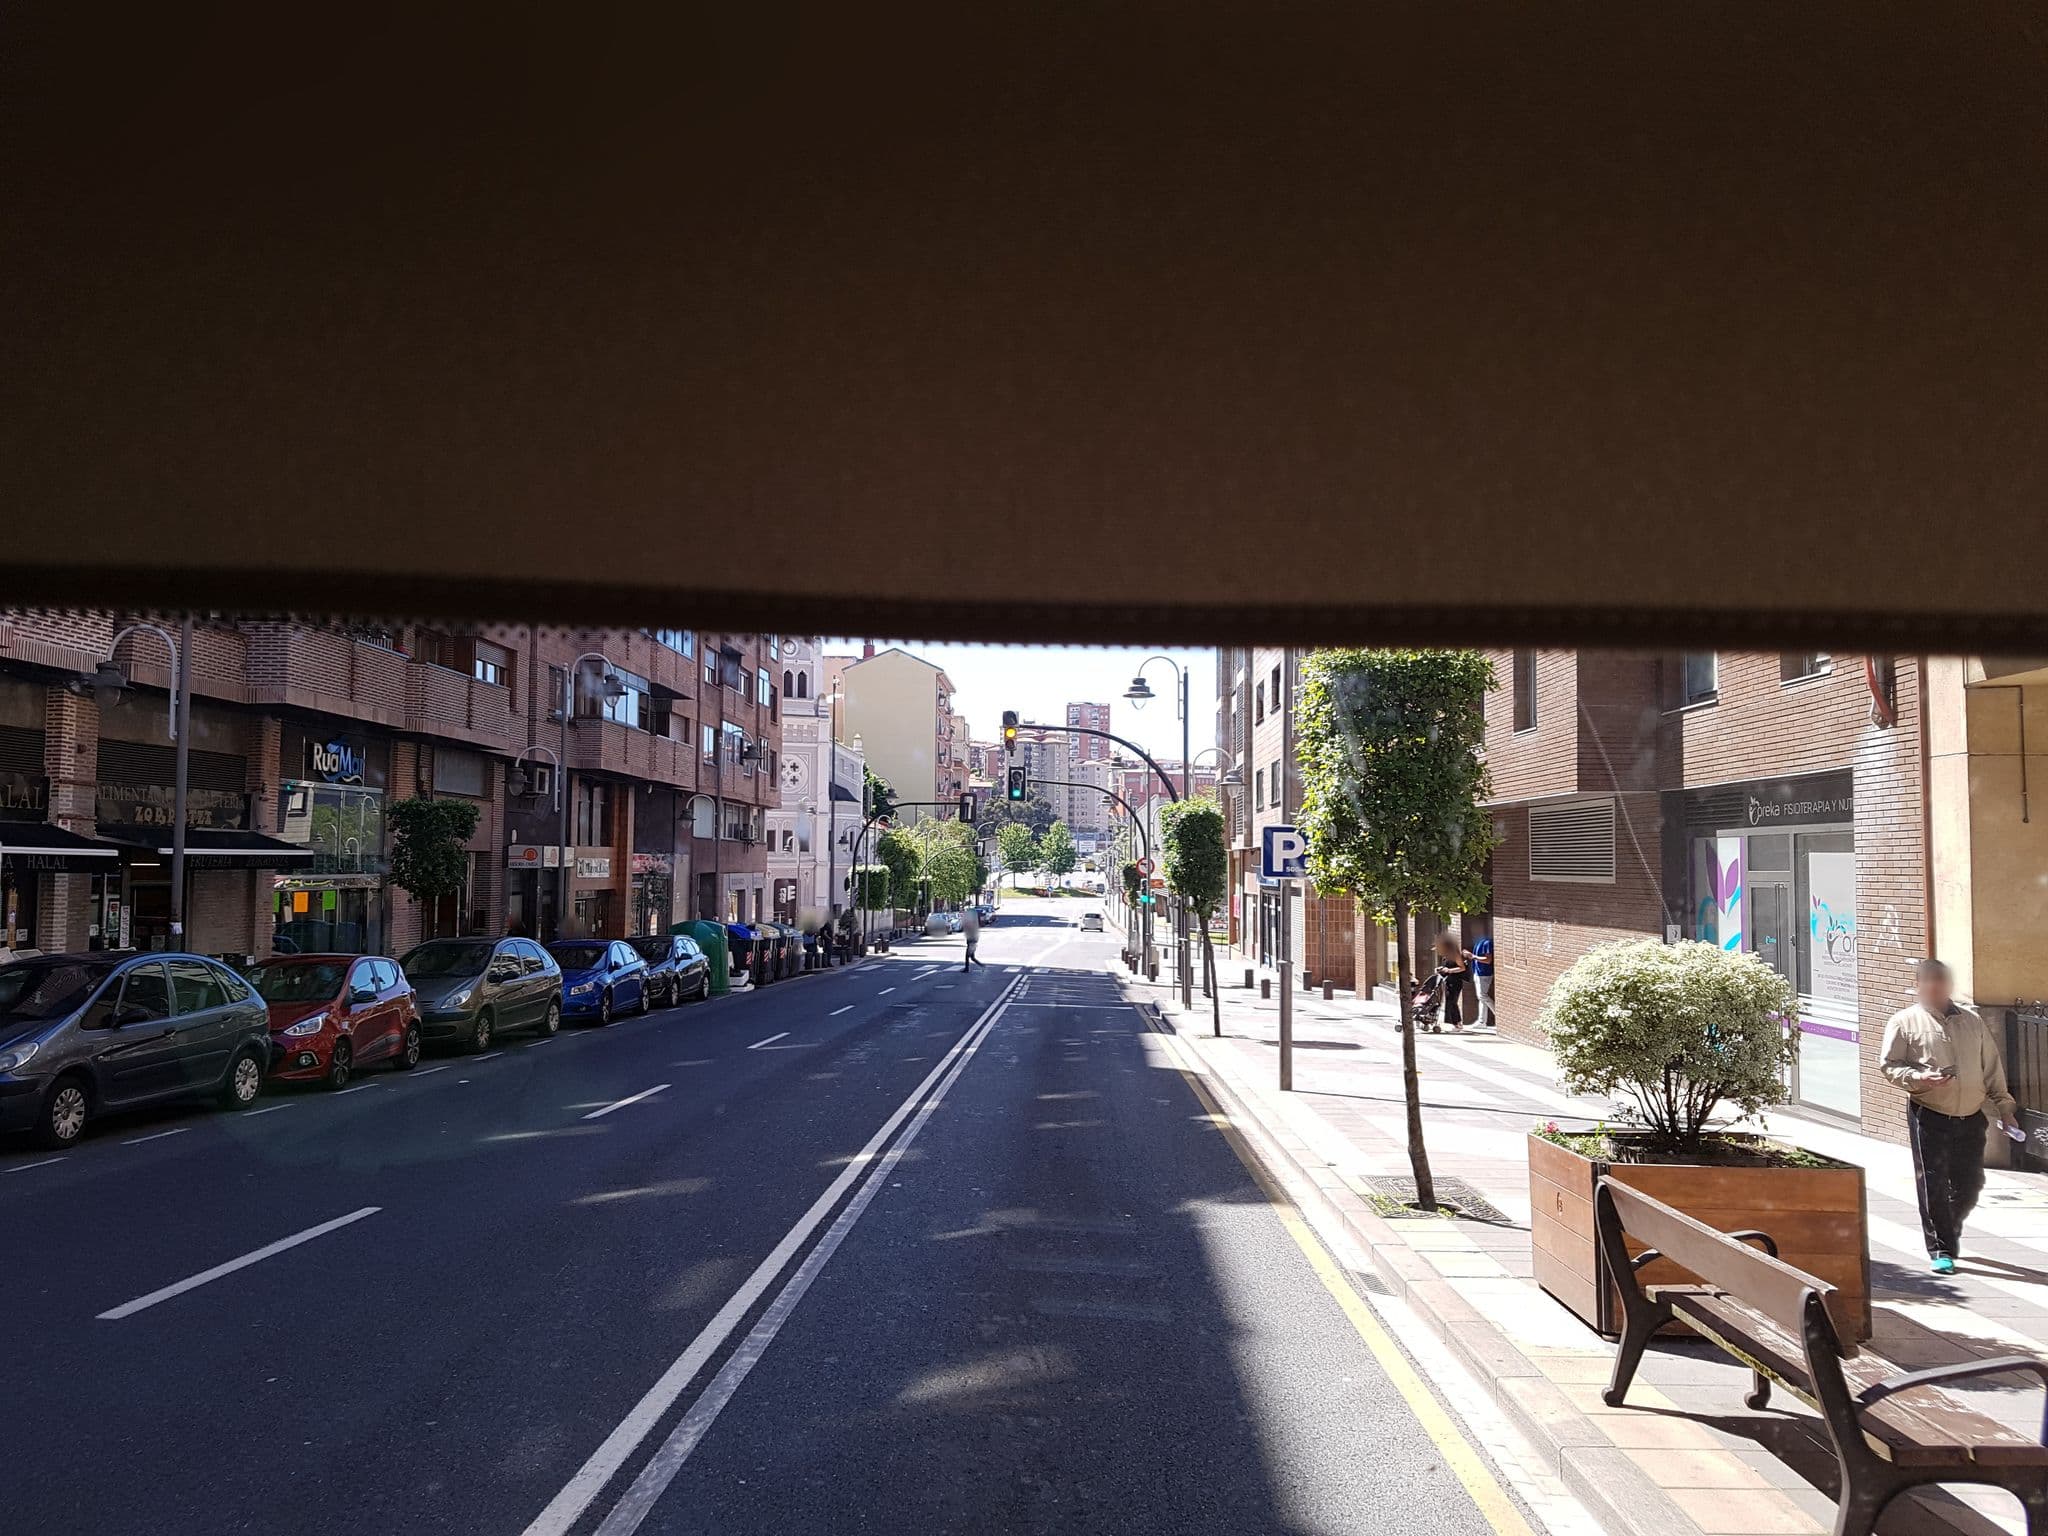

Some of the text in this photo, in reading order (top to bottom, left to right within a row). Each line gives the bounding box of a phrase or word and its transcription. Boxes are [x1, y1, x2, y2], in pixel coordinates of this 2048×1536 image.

[135, 806, 213, 825] ZORRTZA
[1784, 800, 1831, 815] FISIOTERAPIA
[1273, 832, 1306, 872] P
[27, 856, 69, 869] HALAL
